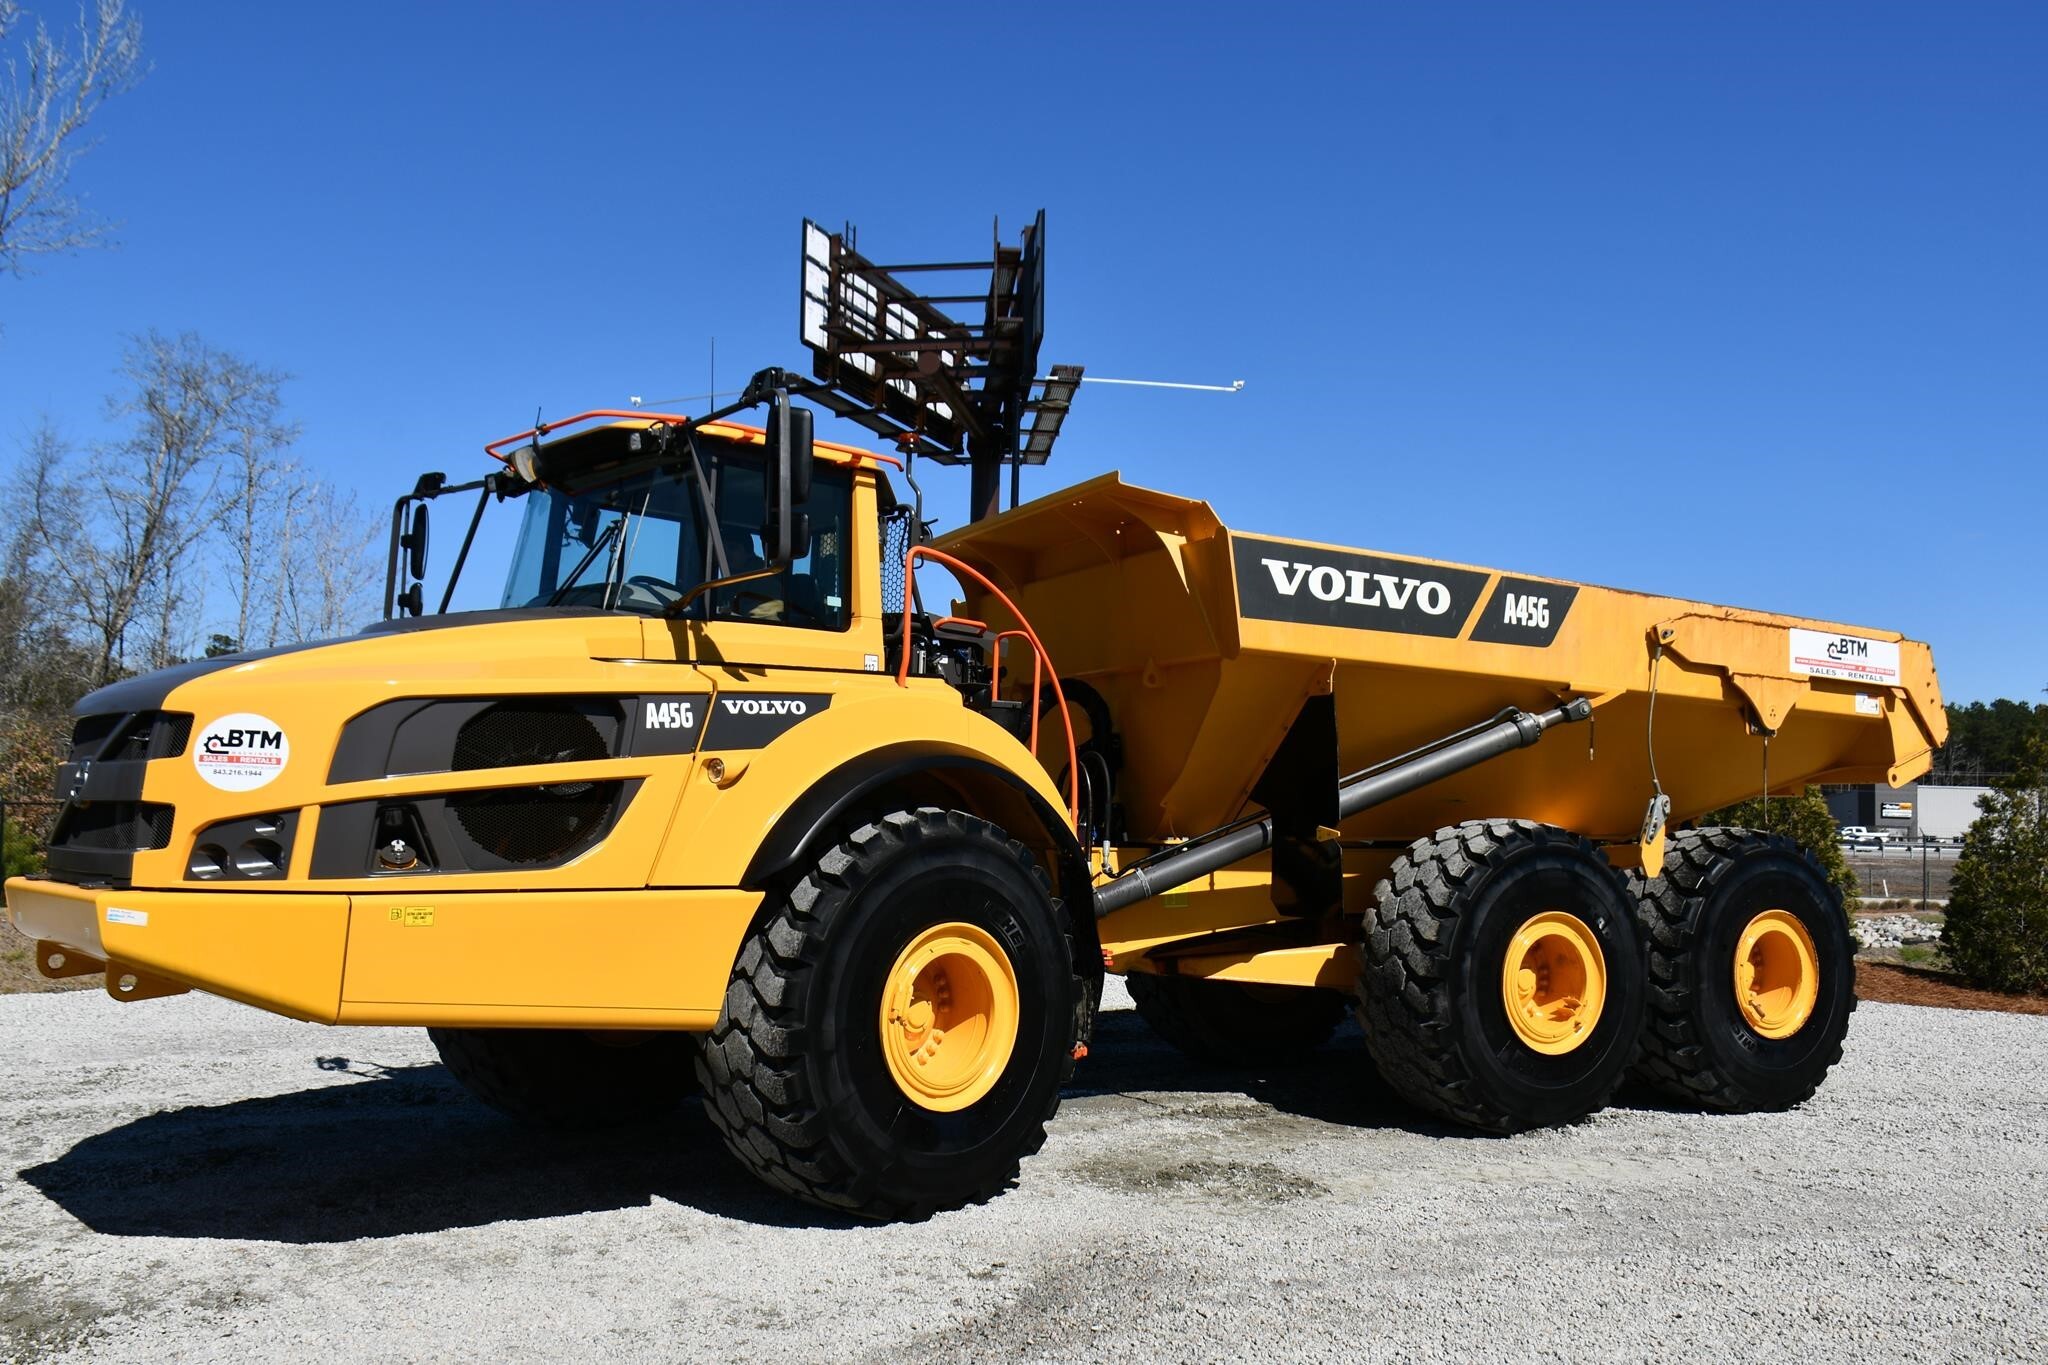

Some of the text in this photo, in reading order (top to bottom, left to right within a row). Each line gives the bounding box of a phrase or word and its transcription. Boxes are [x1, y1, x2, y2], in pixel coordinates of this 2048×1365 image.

[1261, 558, 1451, 616] VOLVO
[1503, 592, 1550, 629] A45G
[1840, 638, 1867, 657] BTM
[1809, 667, 1884, 682] SALES RENTALS
[645, 702, 693, 729] A45G
[721, 700, 807, 715] VOLVO
[227, 729, 282, 749] BTM
[240, 756, 277, 764] RENTALS
